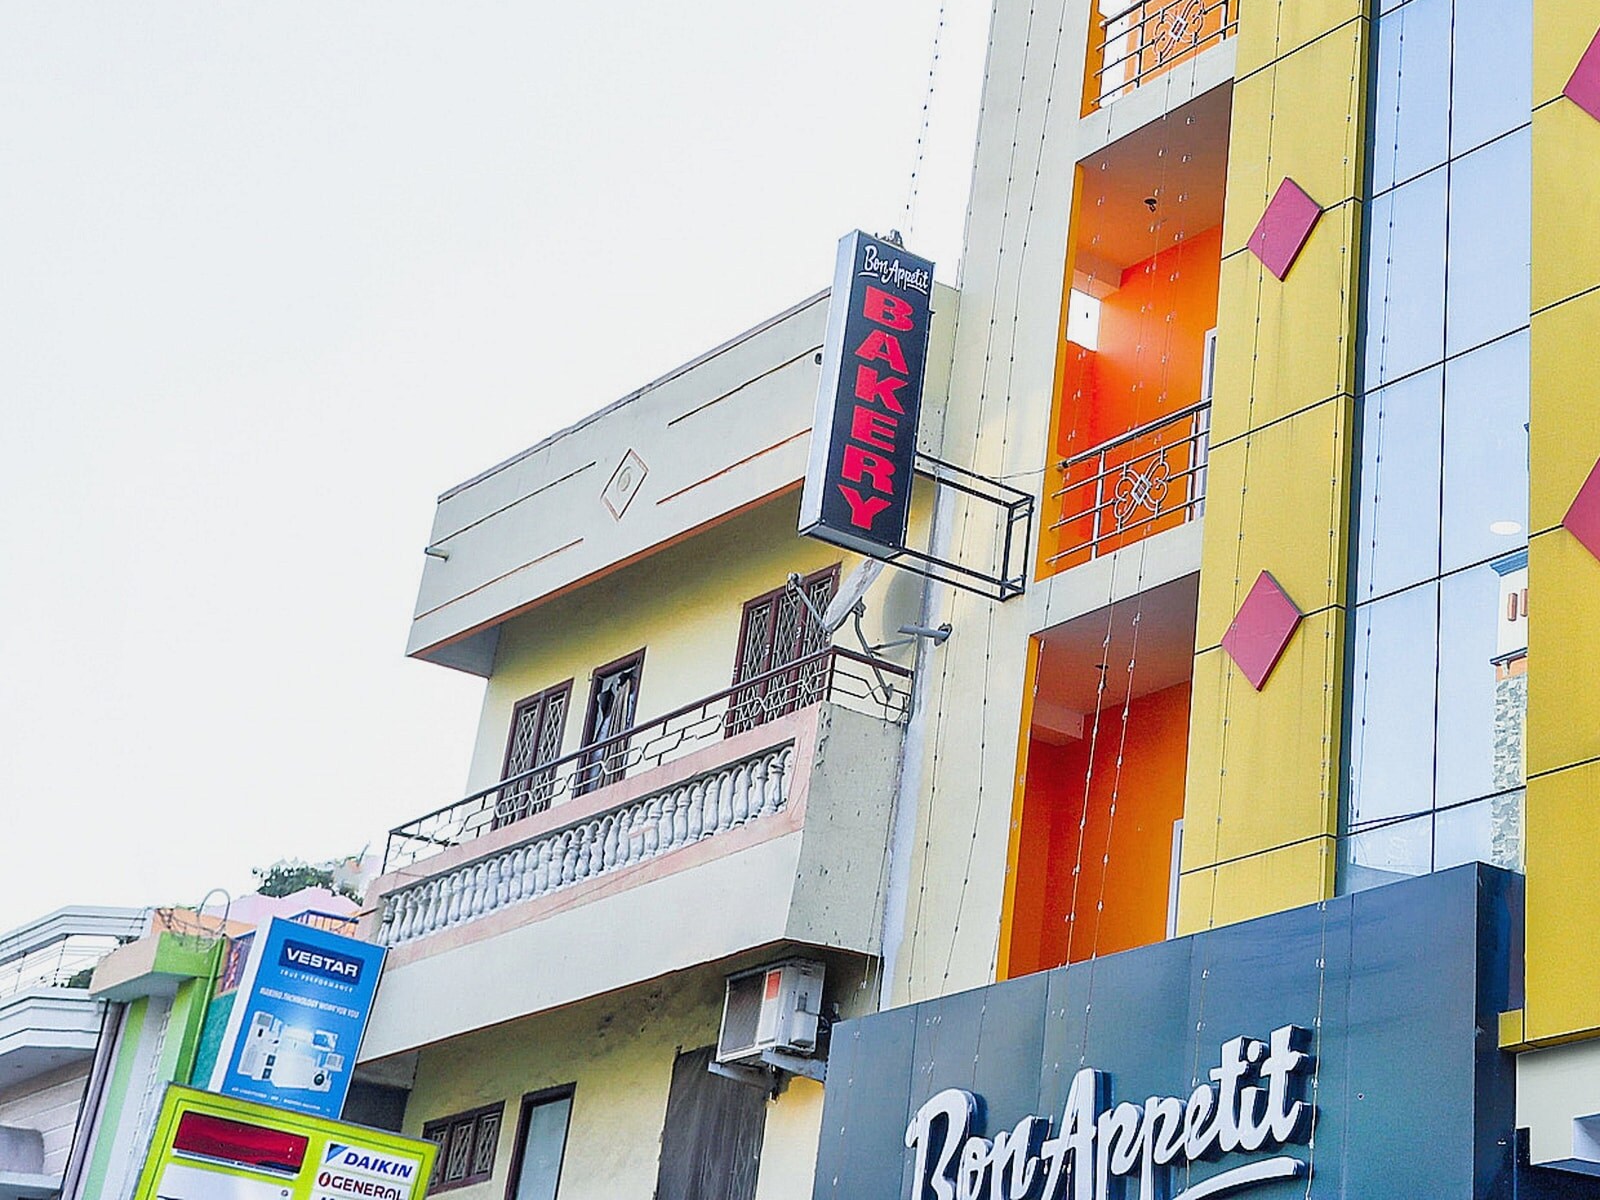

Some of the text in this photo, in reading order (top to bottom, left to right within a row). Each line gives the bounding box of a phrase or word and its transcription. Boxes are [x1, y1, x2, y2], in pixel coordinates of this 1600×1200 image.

[864, 244, 929, 290] Bon Appetit
[838, 285, 914, 531] BAKERY
[287, 947, 359, 978] VESTAR
[905, 1024, 1311, 1200] Bon Appetit
[343, 1152, 413, 1178] DAIKIN
